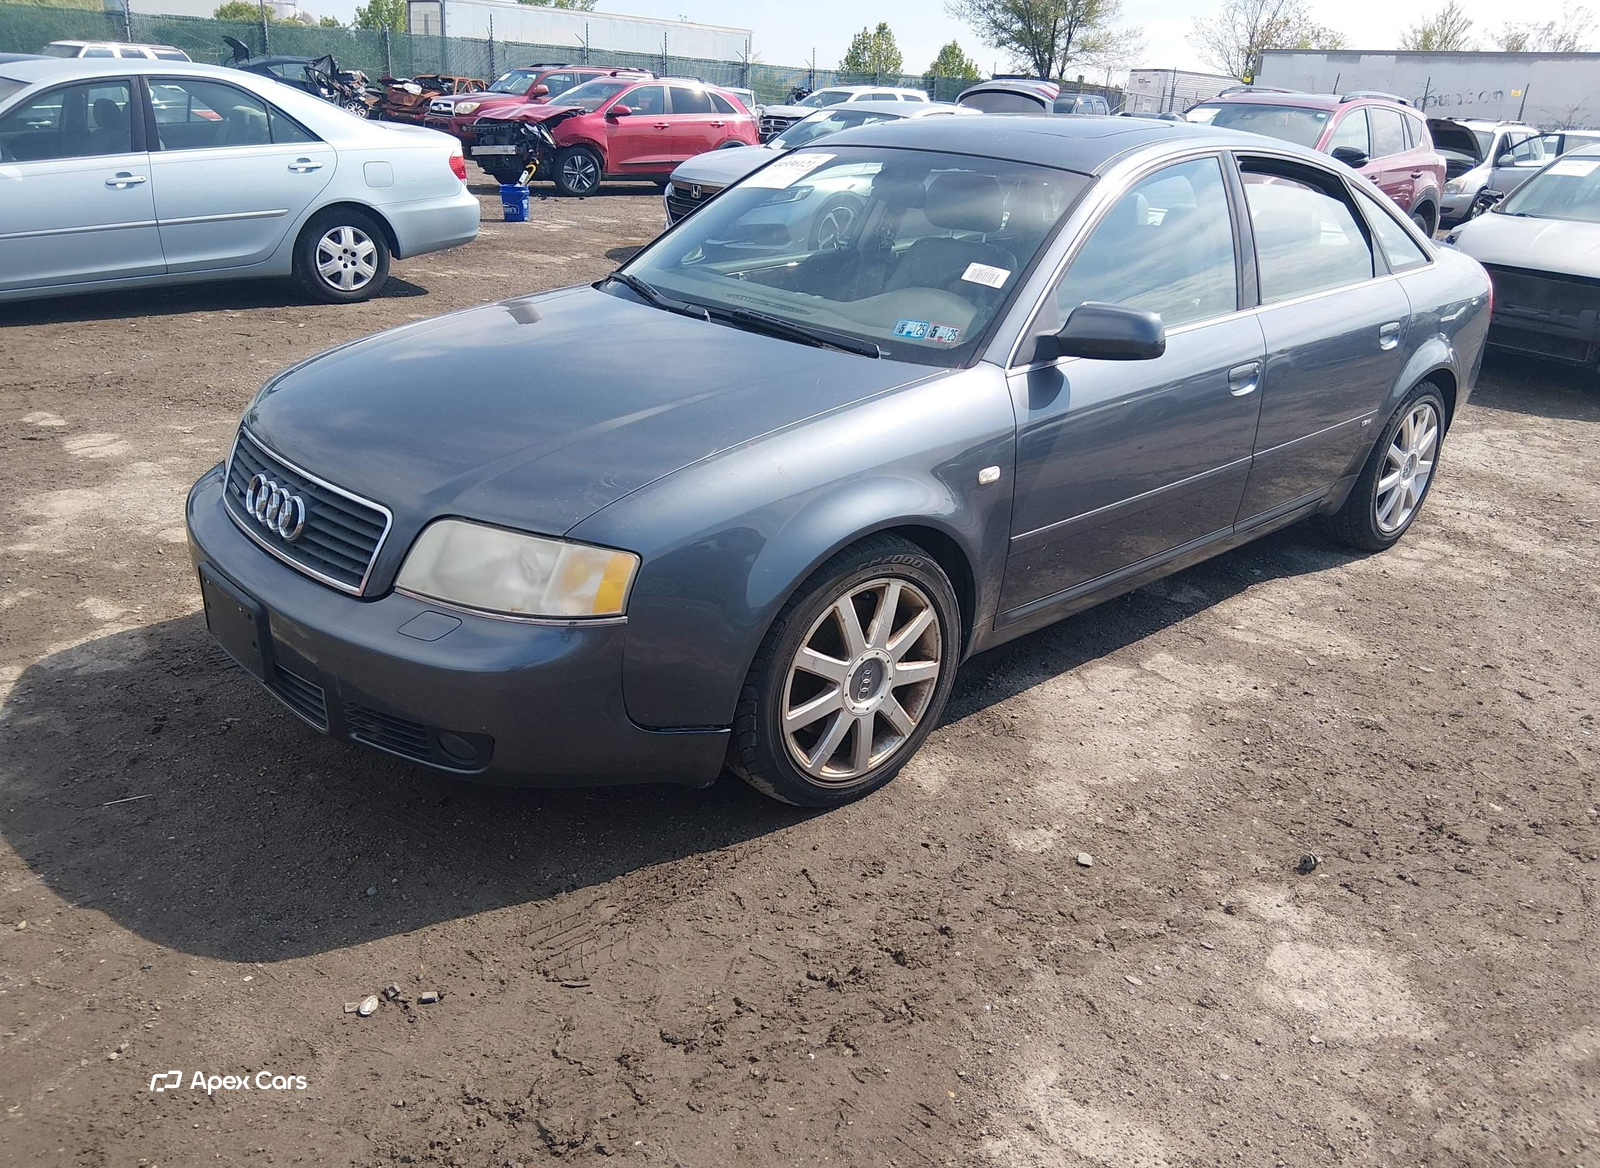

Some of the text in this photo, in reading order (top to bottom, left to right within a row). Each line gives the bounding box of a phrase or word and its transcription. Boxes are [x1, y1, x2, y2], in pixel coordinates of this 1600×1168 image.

[916, 324, 927, 336] 25
[930, 326, 958, 341] 5 25
